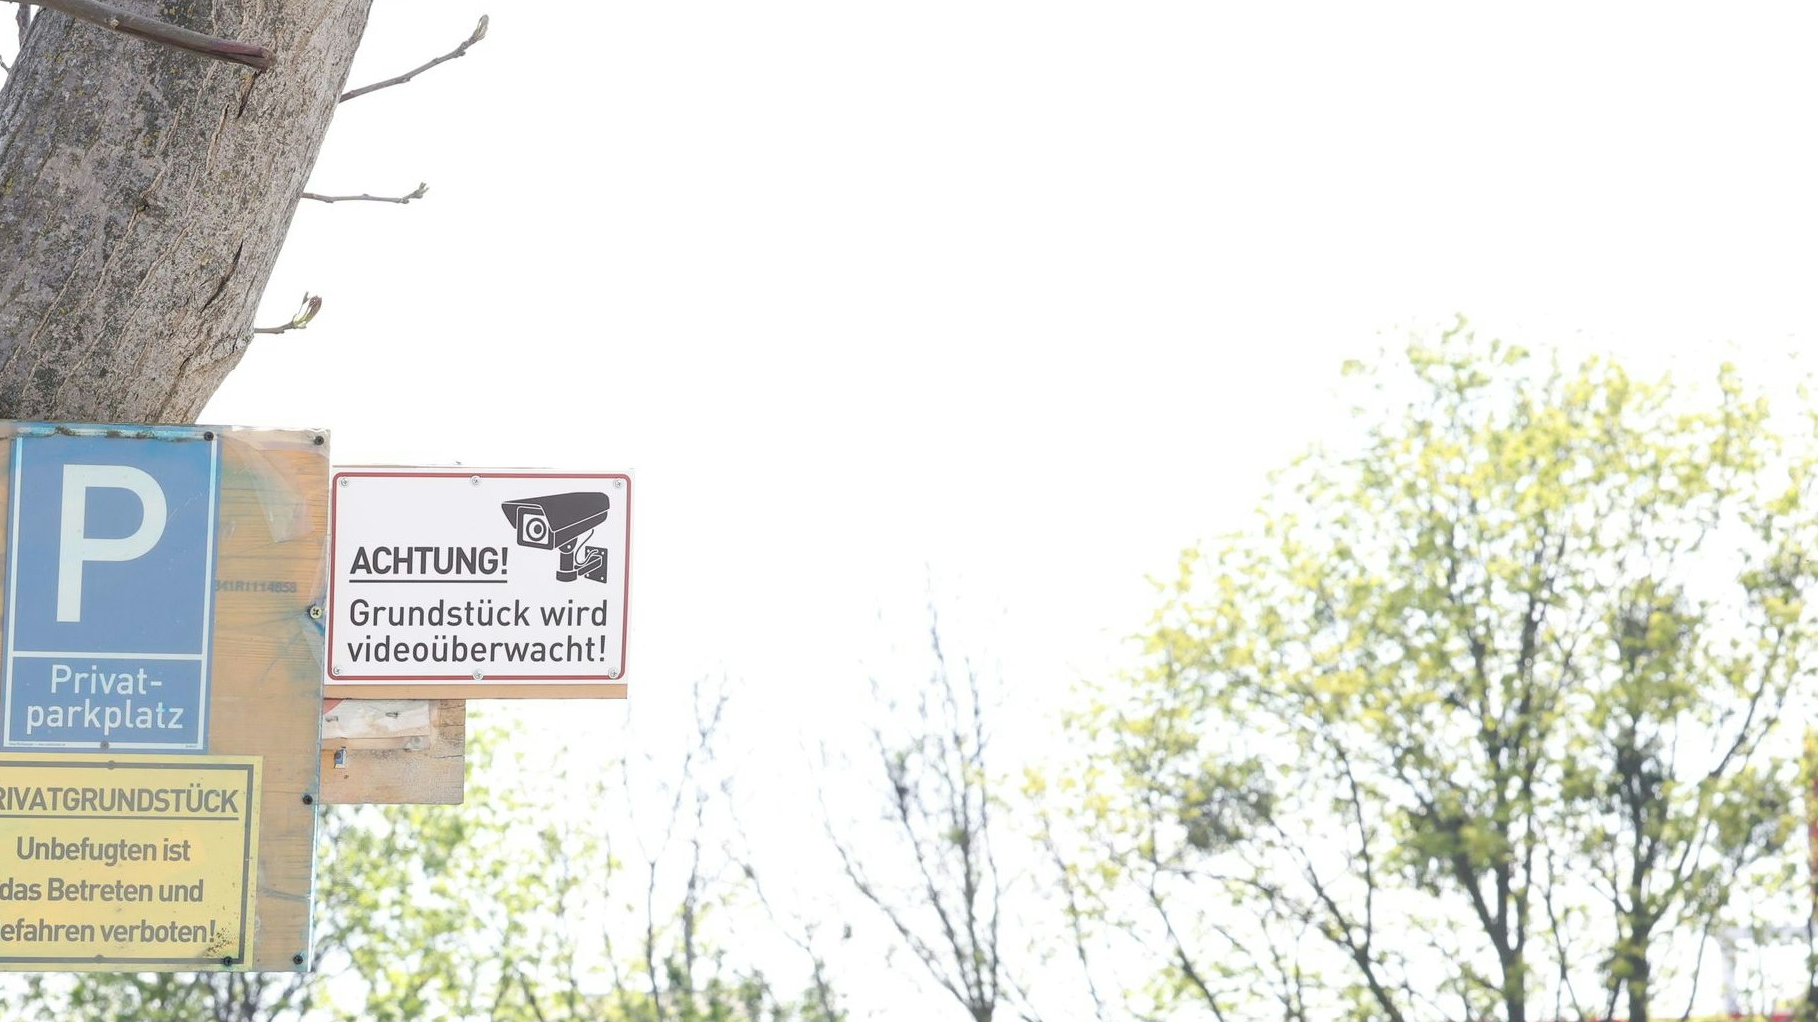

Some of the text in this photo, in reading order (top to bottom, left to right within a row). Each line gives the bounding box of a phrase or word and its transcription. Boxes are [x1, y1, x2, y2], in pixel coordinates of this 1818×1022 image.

[56, 463, 168, 623] P
[349, 546, 508, 575] ACHTUNG!
[350, 599, 607, 627] Grundstück wird
[347, 635, 606, 662] videoüberwacht!
[50, 664, 162, 695] Privat-
[26, 700, 184, 735] parkplatz
[16, 836, 192, 867] Unbefugten ist
[47, 878, 154, 902] Betreten
[159, 878, 204, 903] und
[99, 918, 217, 944] verboten!
